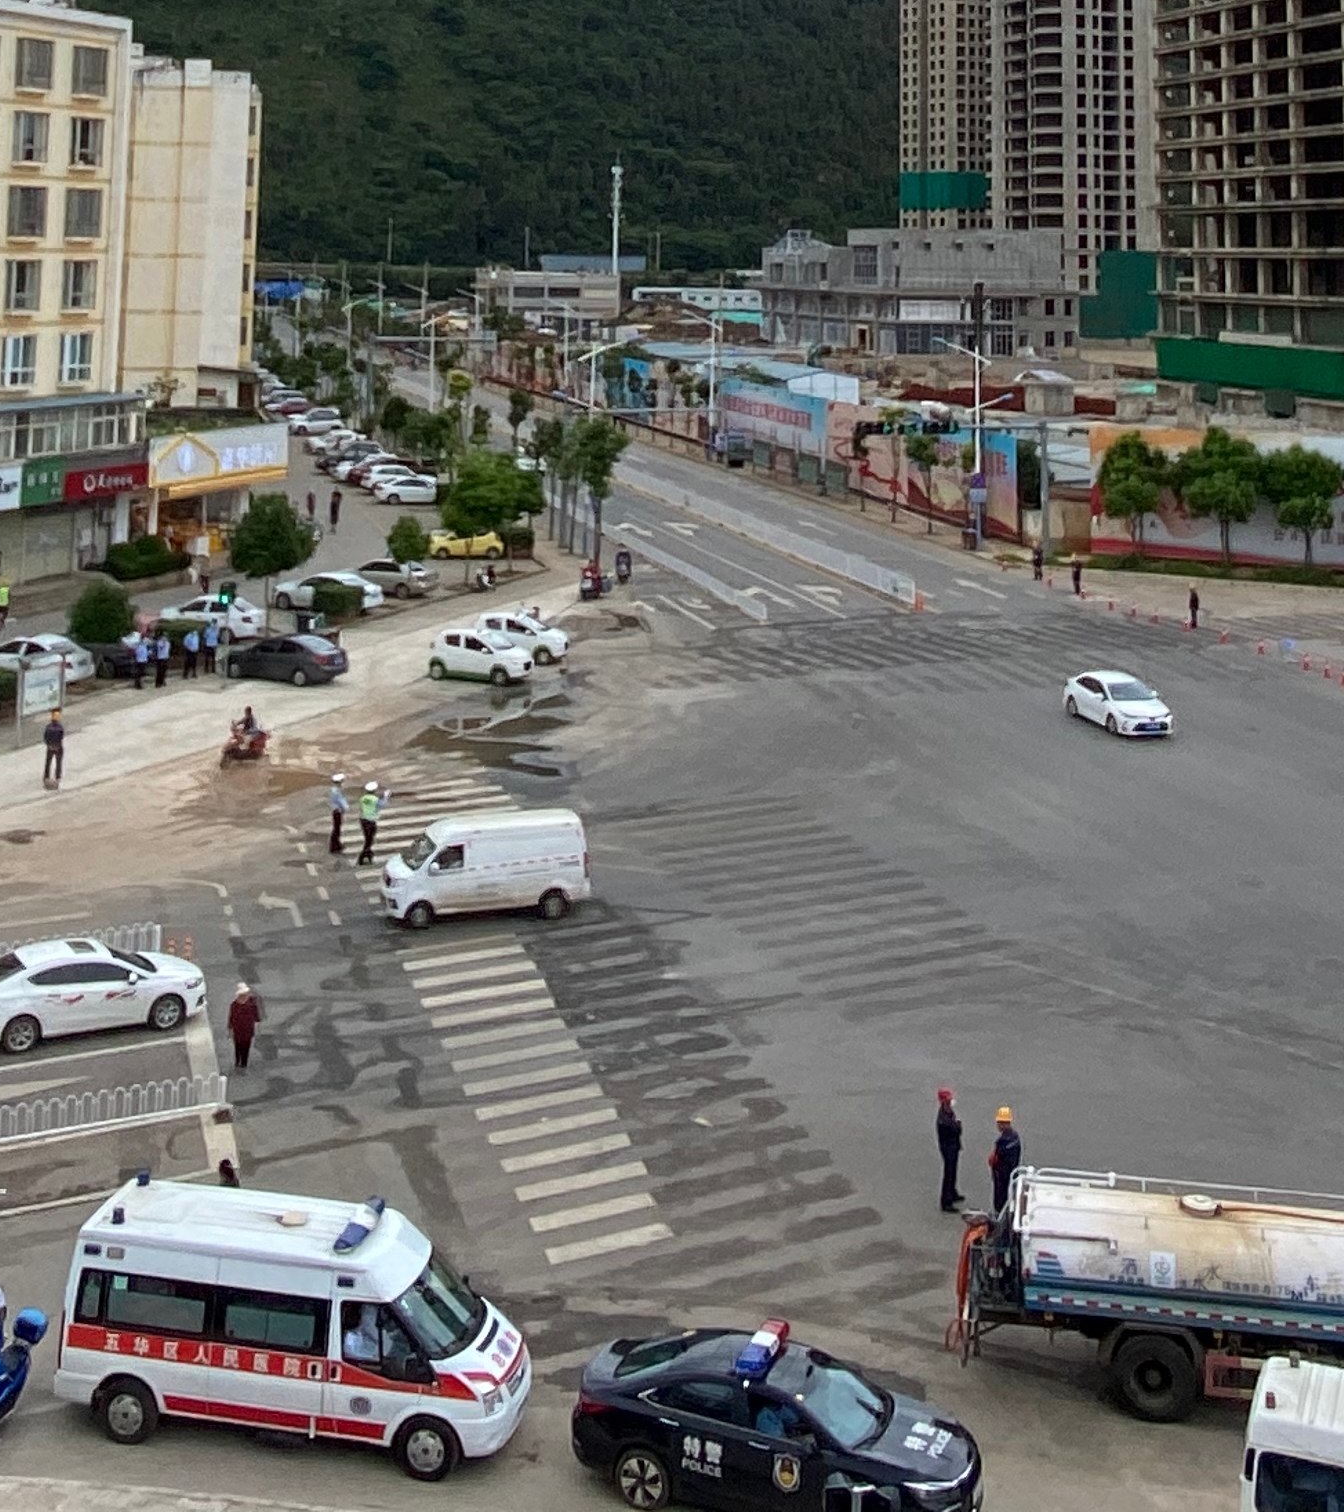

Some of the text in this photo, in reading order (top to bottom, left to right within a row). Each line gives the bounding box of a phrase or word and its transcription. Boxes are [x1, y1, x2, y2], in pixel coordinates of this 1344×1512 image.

[103, 1331, 301, 1378] 五华区人民医院
[681, 1457, 723, 1478] POLICE
